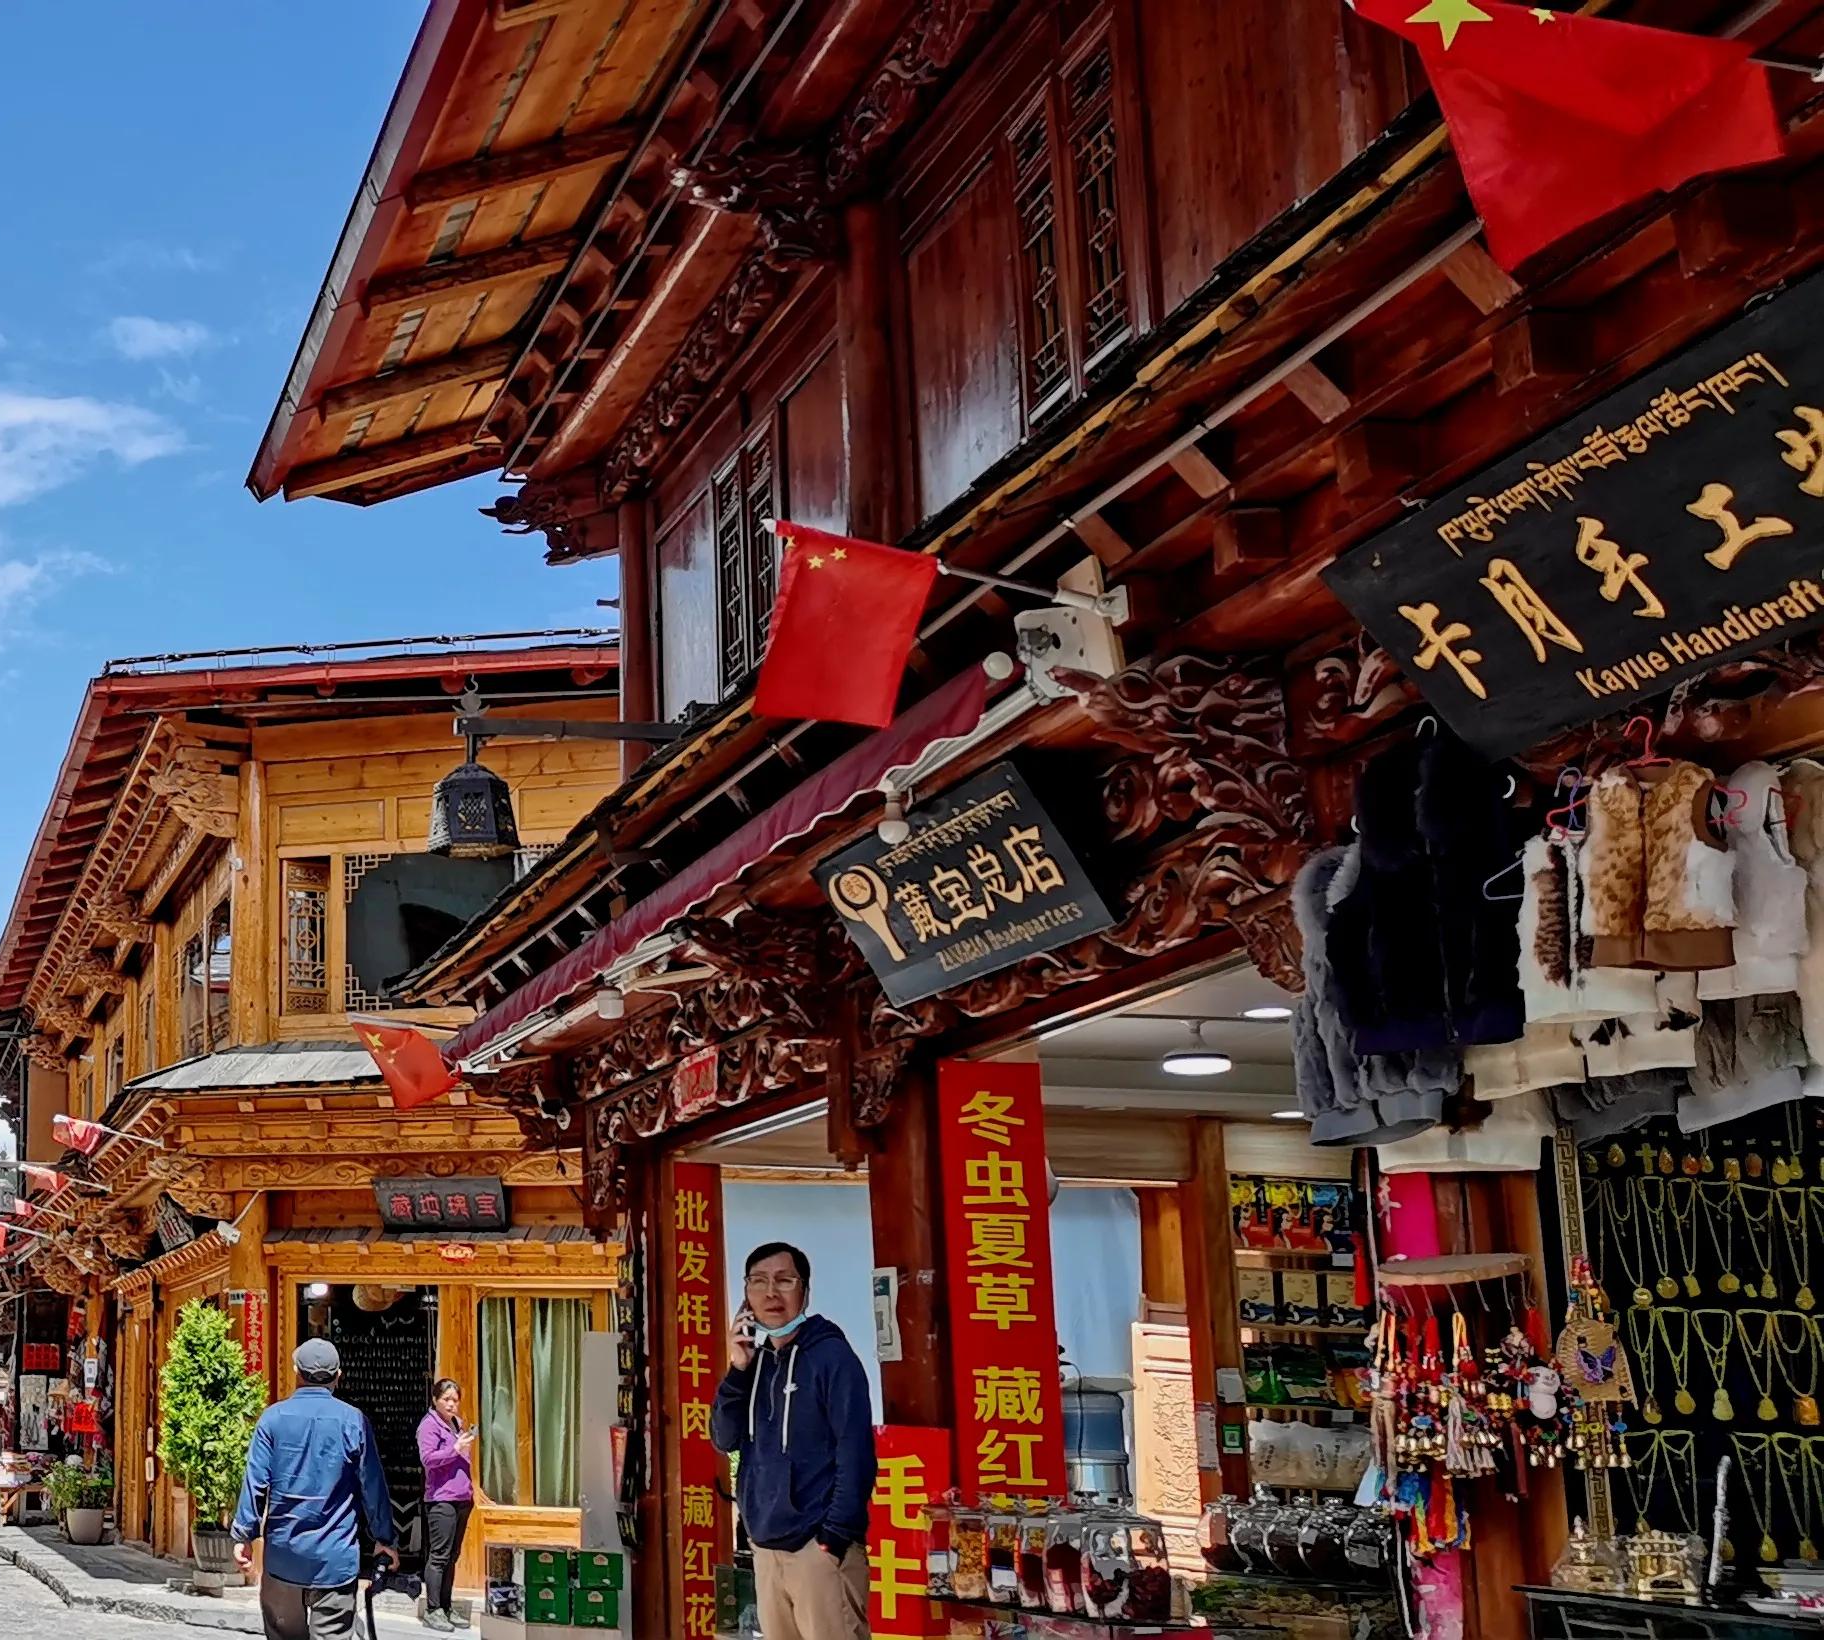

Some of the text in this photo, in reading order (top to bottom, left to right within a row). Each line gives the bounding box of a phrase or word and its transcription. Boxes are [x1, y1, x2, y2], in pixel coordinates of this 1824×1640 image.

[1575, 578, 1824, 699] Kayue Handicraft
[894, 823, 1066, 943] 藏宝总店
[984, 901, 1084, 951] Headquarters
[958, 1089, 1049, 1508] 冬虫夏草 藏红
[675, 1188, 716, 1638] 批发牦牛肉 藏红花
